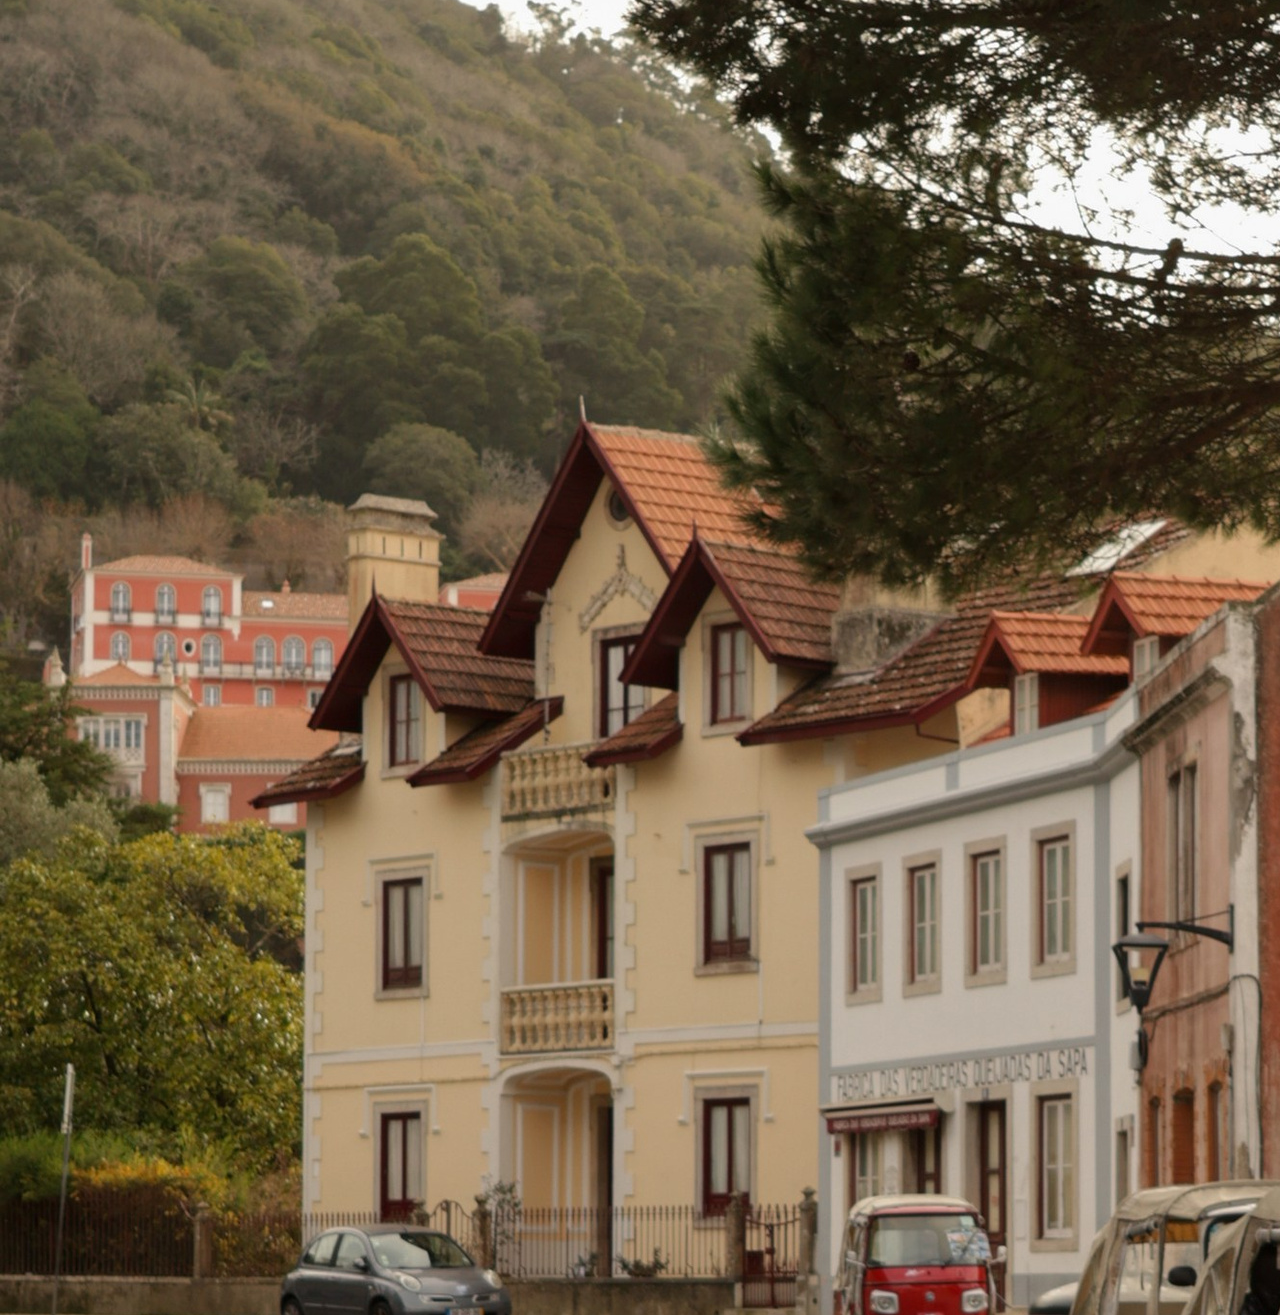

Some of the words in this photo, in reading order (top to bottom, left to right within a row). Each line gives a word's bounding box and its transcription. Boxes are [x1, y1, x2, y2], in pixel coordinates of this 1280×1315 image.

[880, 1069, 899, 1097] DAS
[904, 1062, 968, 1093] VERDADEIRAS
[974, 1054, 1031, 1086] QUEIJADAS
[1037, 1051, 1051, 1080] DA
[1058, 1048, 1088, 1078] SAPA
